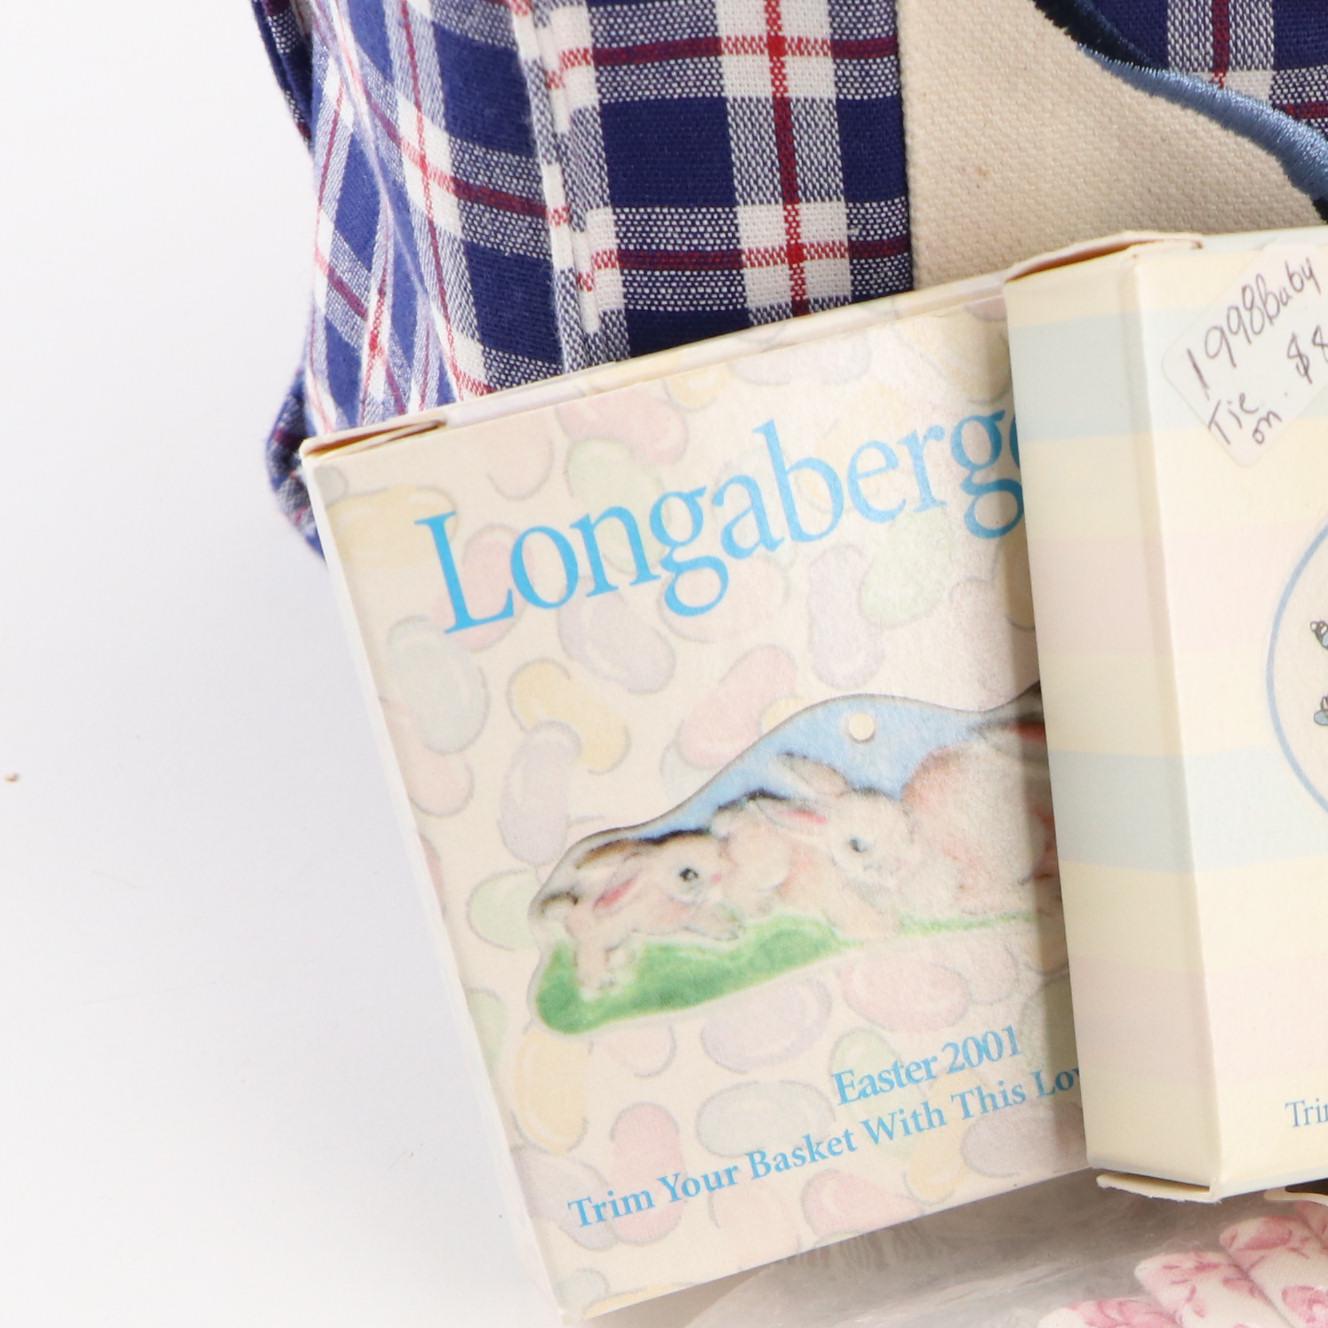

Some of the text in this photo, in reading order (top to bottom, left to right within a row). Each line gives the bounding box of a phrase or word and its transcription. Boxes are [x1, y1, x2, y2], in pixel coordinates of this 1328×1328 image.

[1208, 392, 1259, 446] Tie
[1252, 410, 1283, 445] on
[415, 408, 1025, 635] Longaberg
[832, 1023, 1023, 1105] Easter 2001
[567, 1066, 1080, 1228] Trim Your Basket With This Lo
